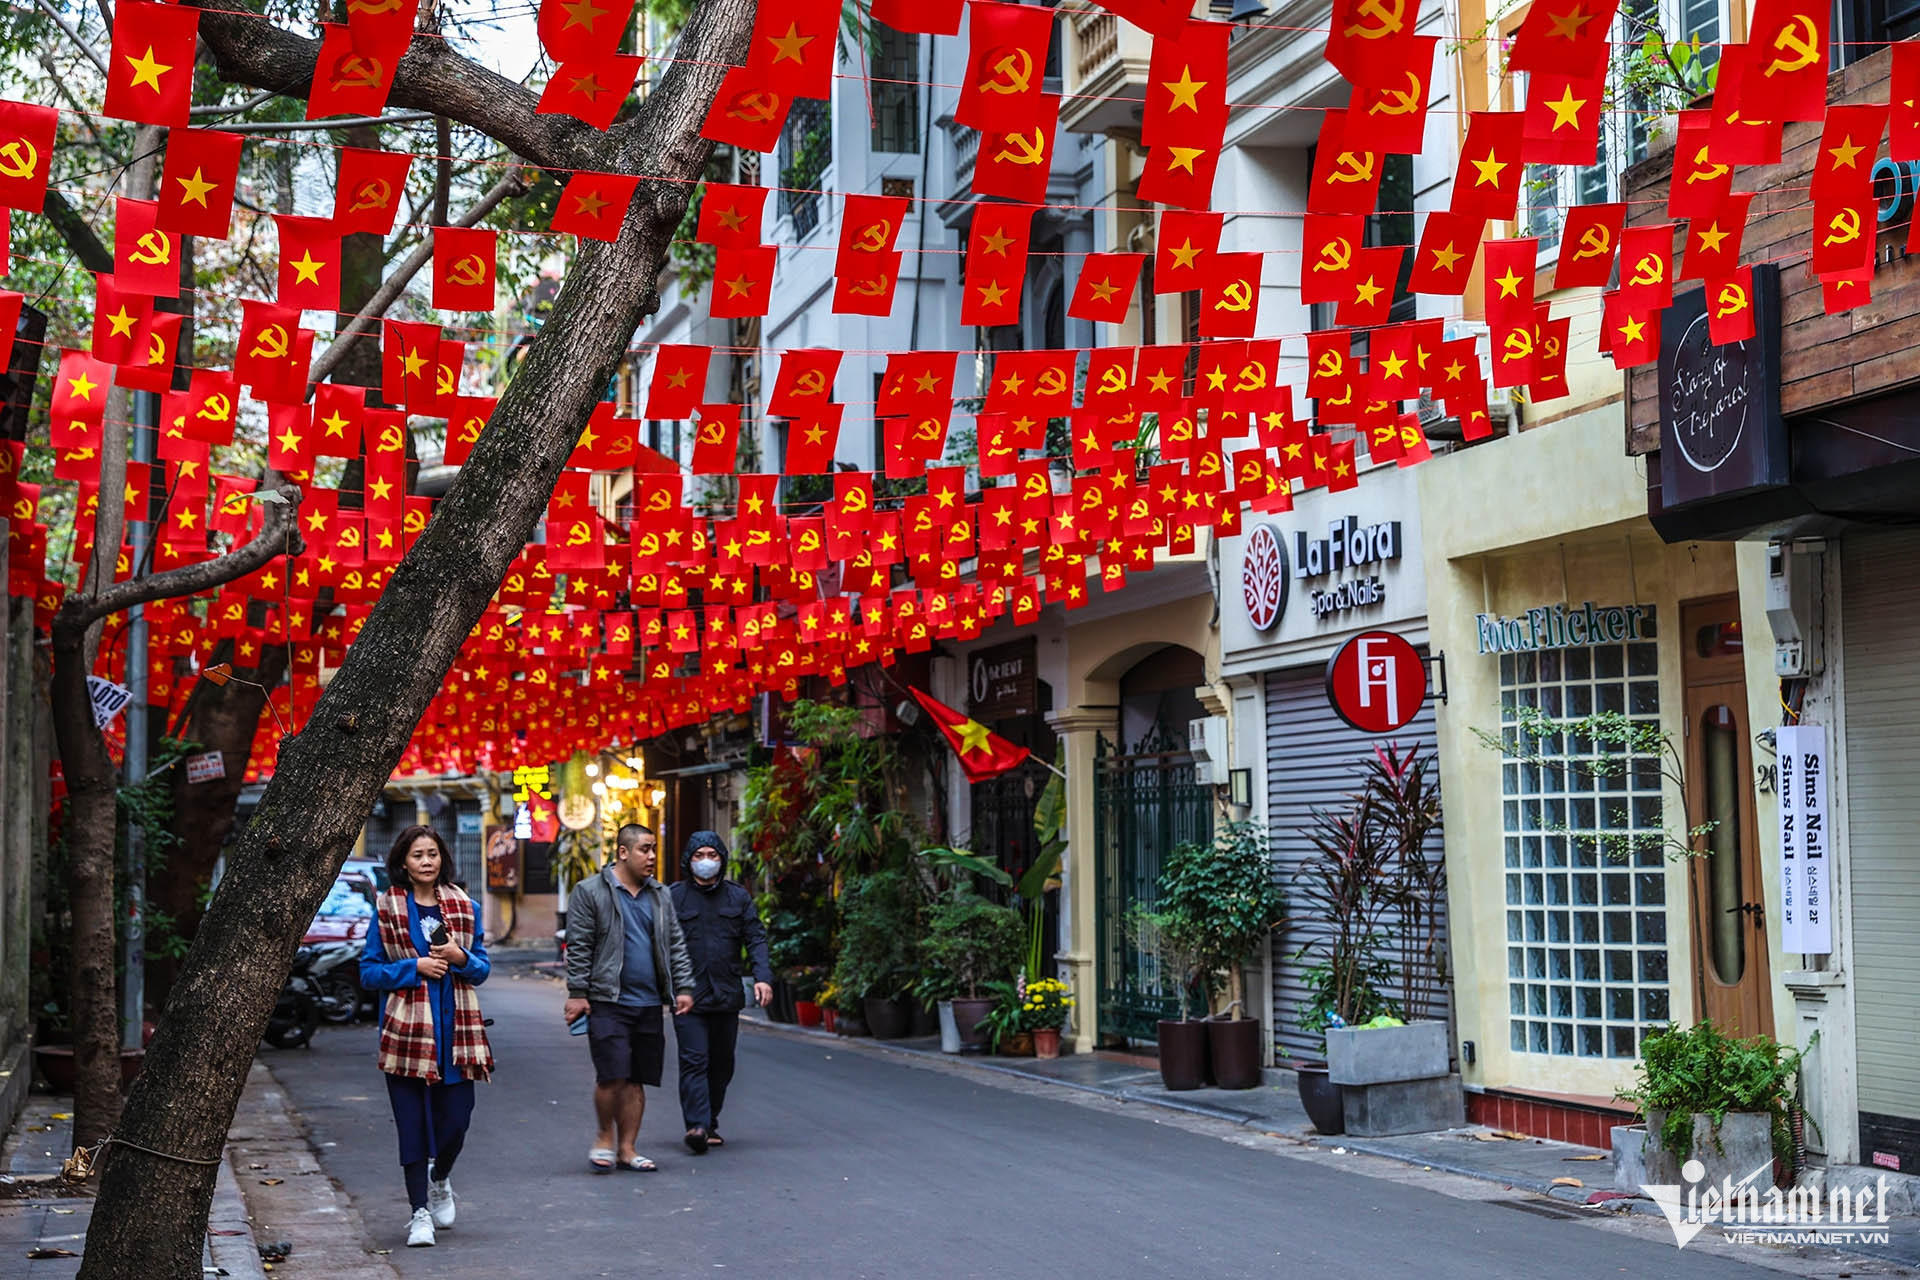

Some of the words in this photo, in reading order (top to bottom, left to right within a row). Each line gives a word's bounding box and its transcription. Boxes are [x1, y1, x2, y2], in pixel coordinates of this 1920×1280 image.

[1293, 531, 1328, 579] La
[1328, 515, 1402, 571] Flora
[1311, 589, 1335, 619] Spa
[1335, 583, 1350, 610] &
[1347, 576, 1384, 607] Nails
[1475, 601, 1642, 655] Foto.Flicker
[1782, 755, 1793, 809] Sims
[1804, 753, 1820, 808] Sims
[1783, 814, 1794, 860] Nail
[1806, 813, 1822, 860] Nail
[1809, 909, 1819, 925] 2F
